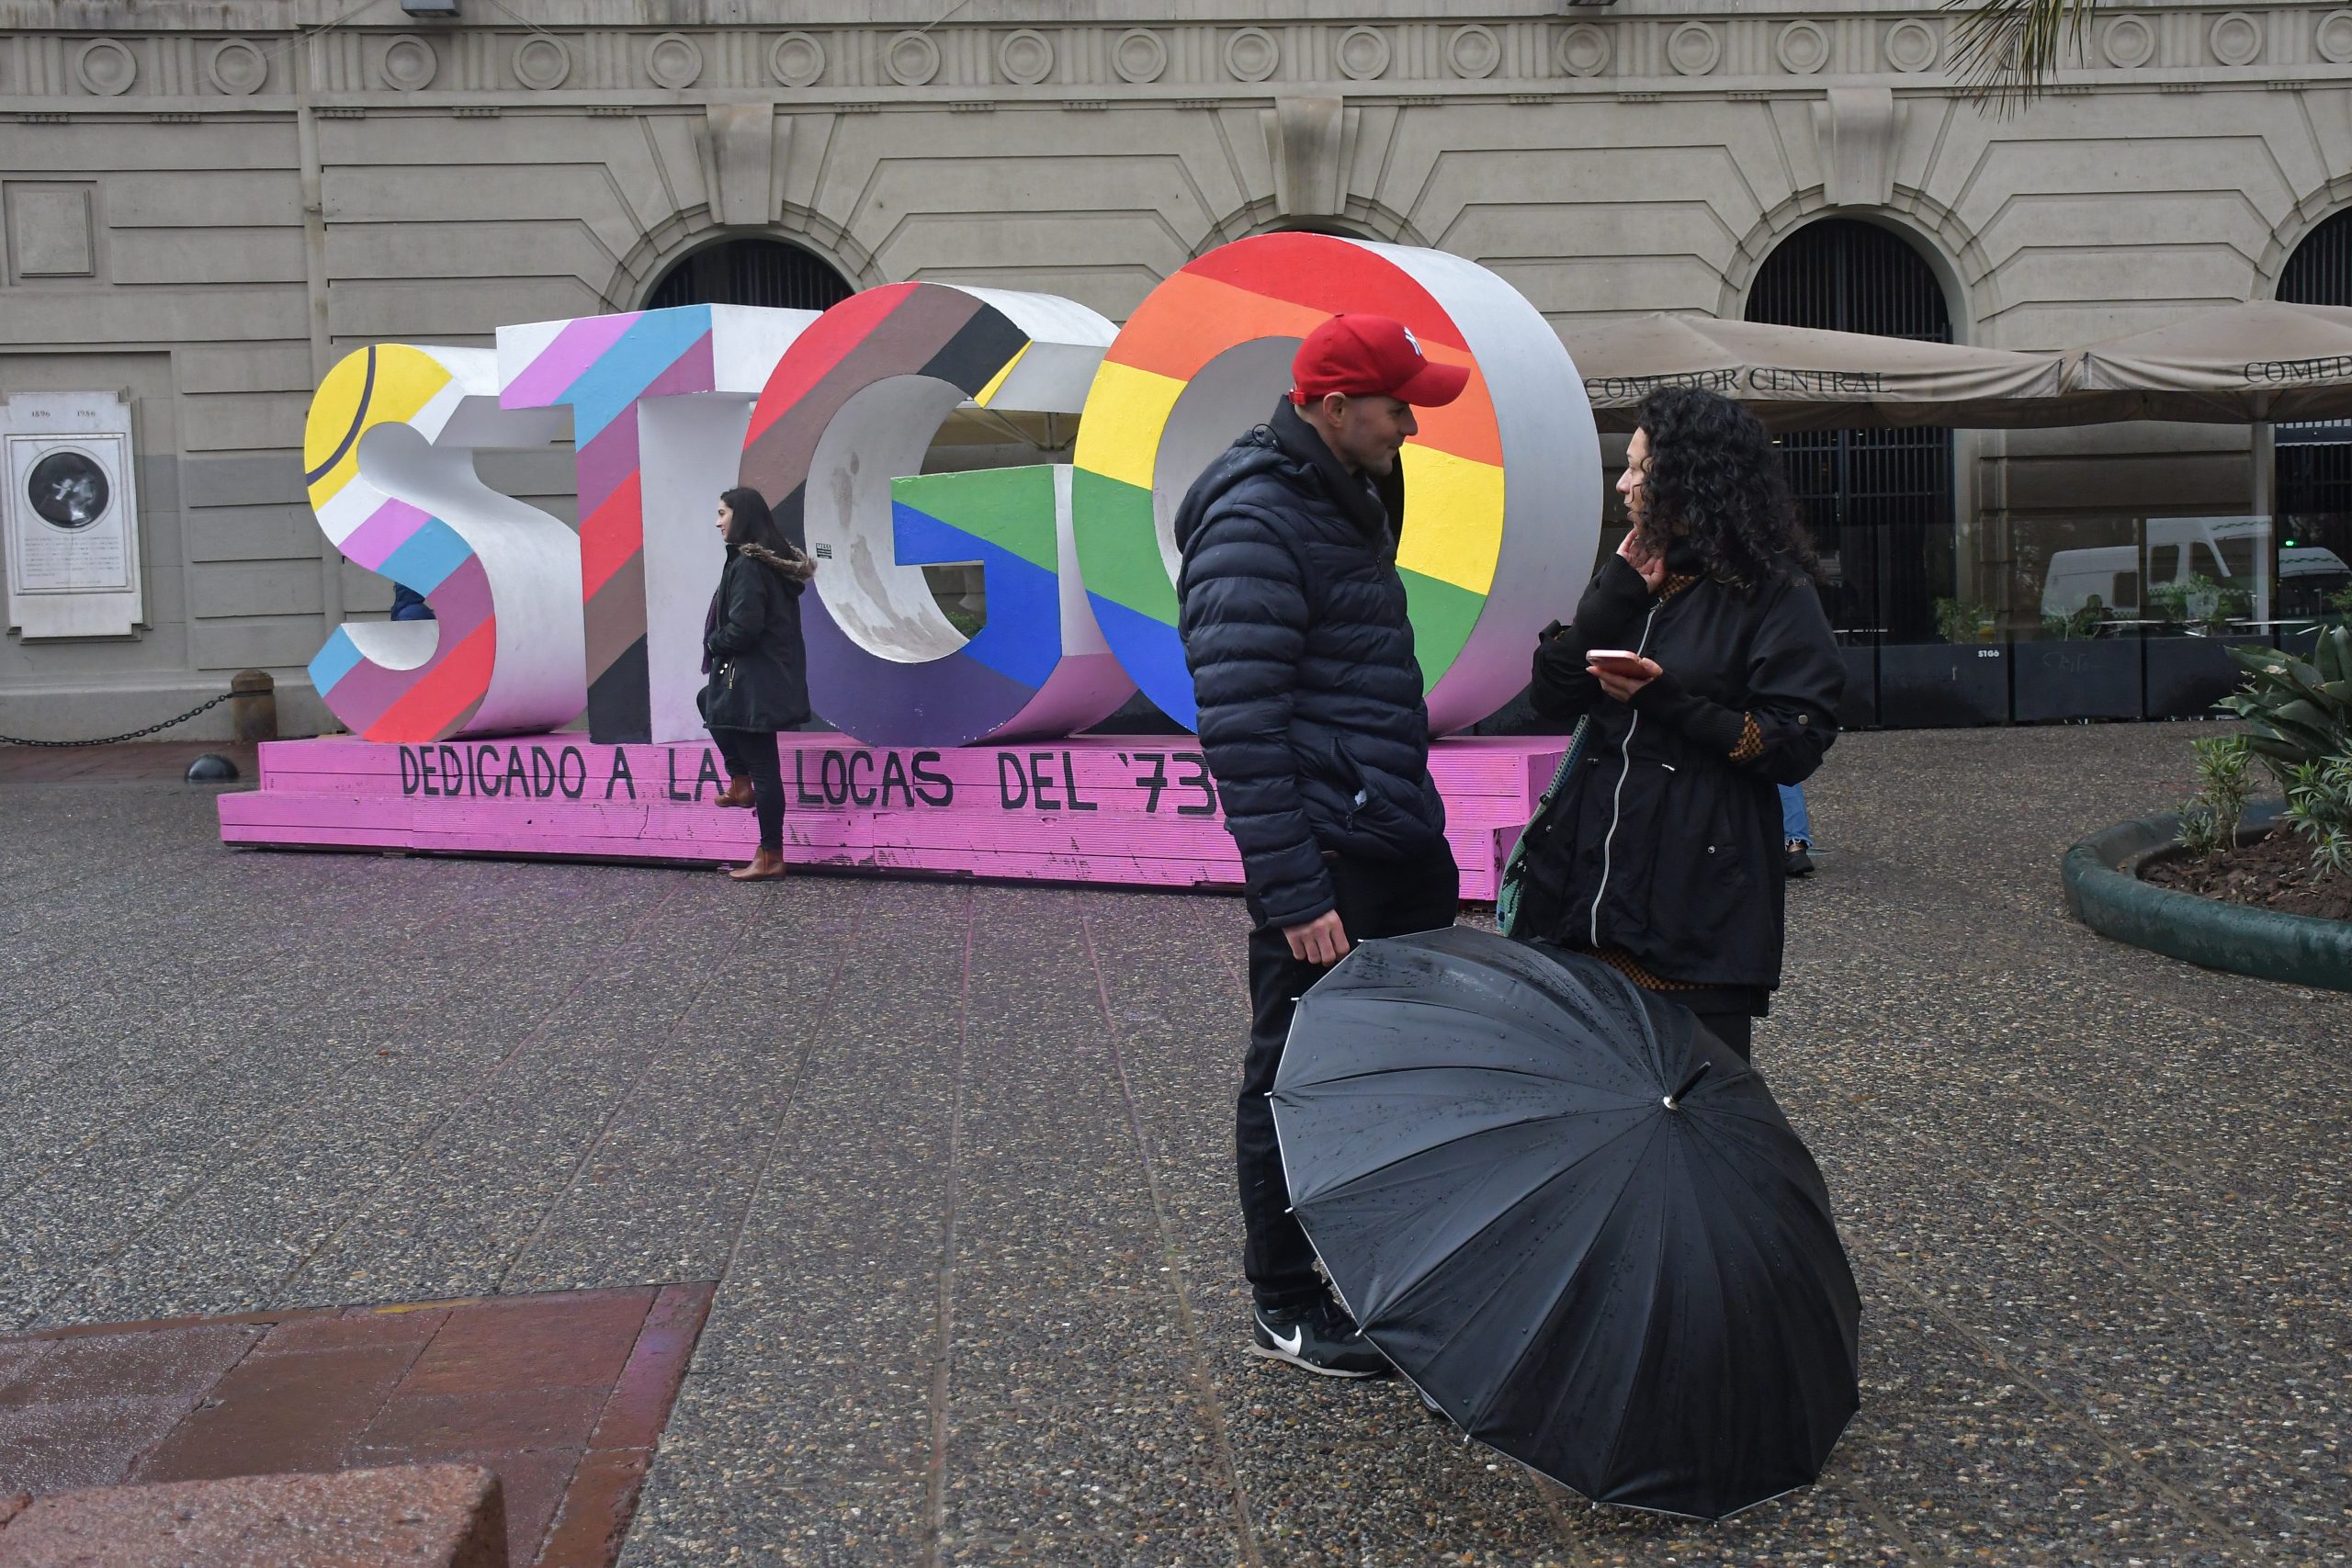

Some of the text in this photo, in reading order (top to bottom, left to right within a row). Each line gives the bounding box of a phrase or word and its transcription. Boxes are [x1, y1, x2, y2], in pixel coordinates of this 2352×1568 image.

[1584, 367, 1893, 400] COMEDOR CENTRAL
[304, 232, 1600, 746] STGO
[399, 744, 586, 799] DEDICADO
[605, 746, 636, 799] A
[668, 747, 725, 802] LA
[796, 749, 954, 808] LOCAS
[998, 750, 1098, 810] DEL
